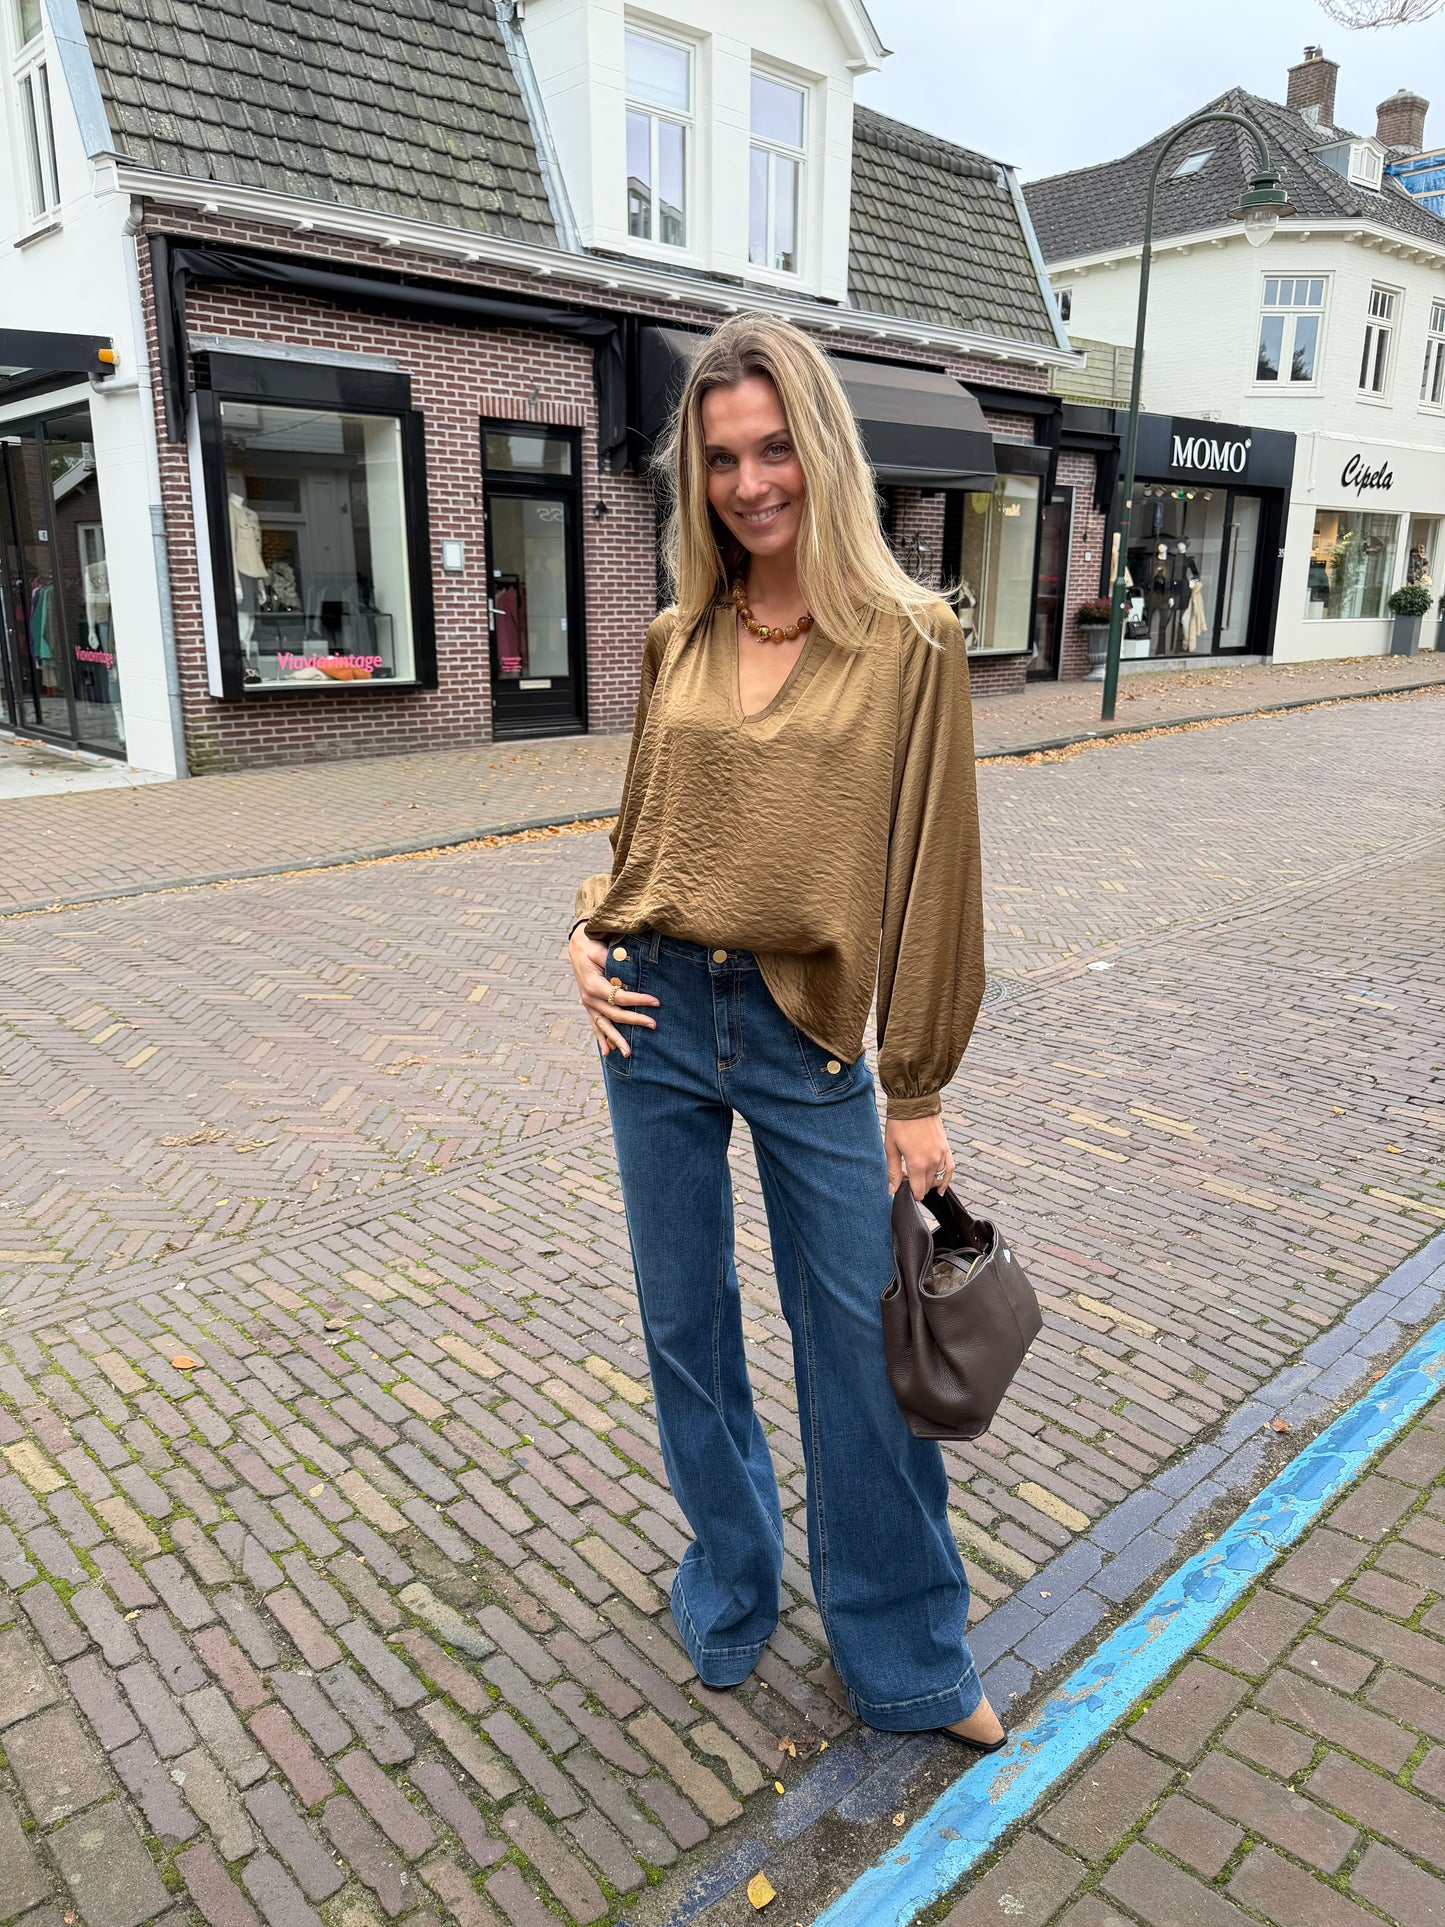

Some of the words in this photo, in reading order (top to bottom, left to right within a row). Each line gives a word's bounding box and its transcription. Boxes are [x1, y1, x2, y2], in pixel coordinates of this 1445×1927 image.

[1171, 435, 1247, 473] MOMO
[1341, 453, 1394, 497] Cipela
[276, 652, 382, 672] Viaviavintage
